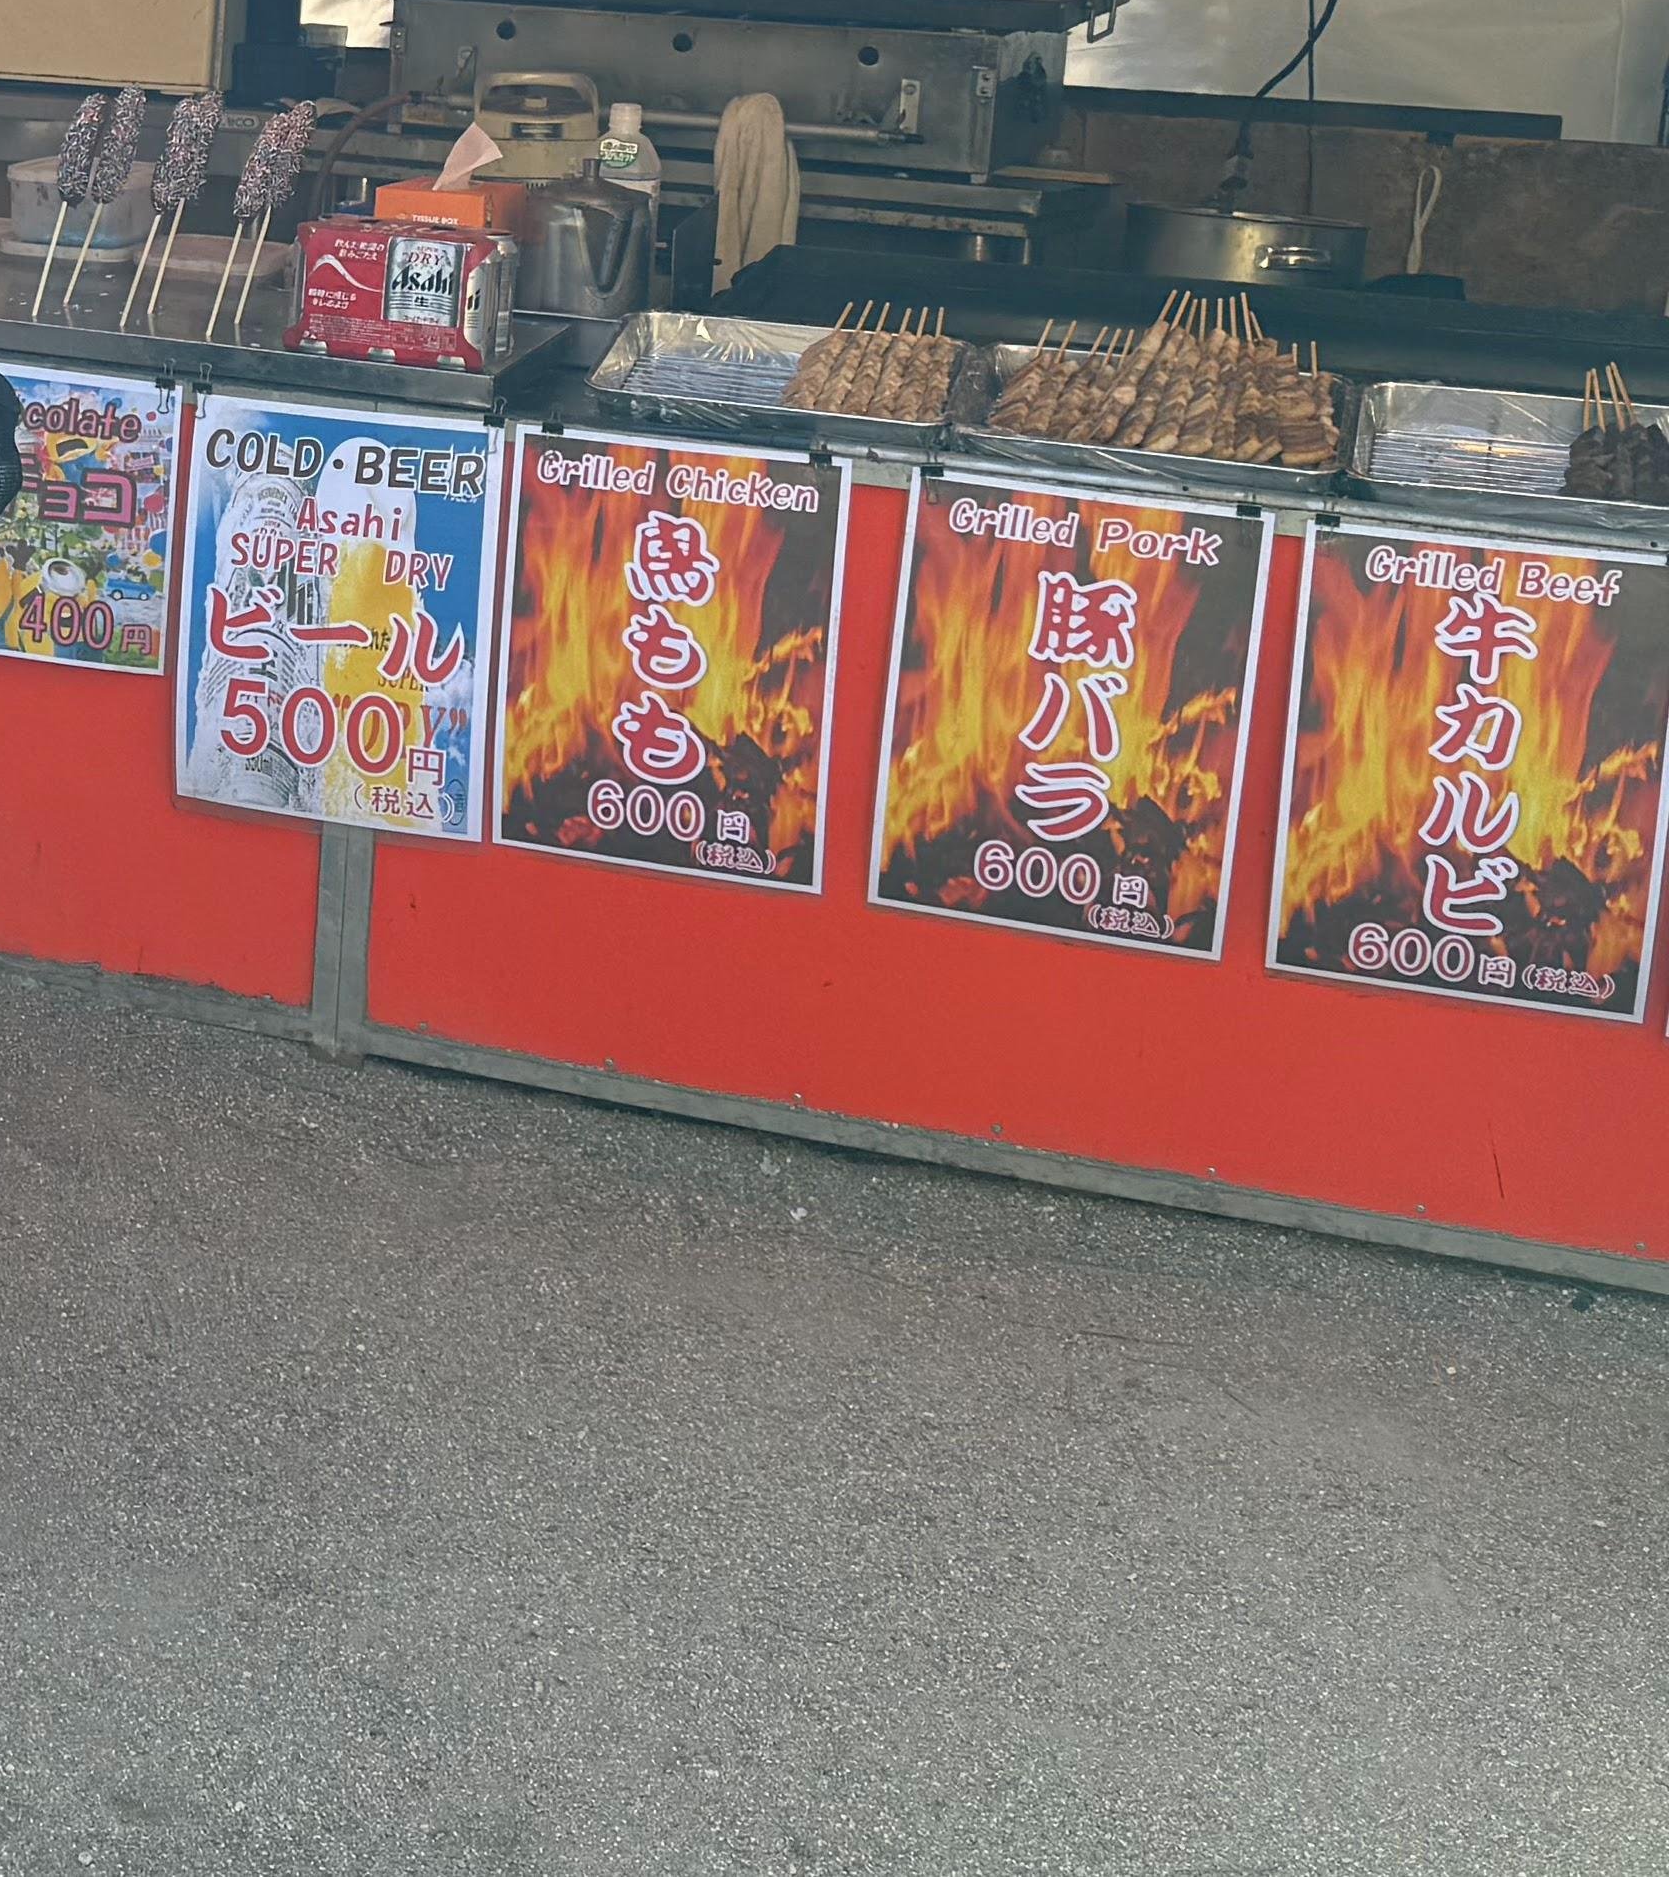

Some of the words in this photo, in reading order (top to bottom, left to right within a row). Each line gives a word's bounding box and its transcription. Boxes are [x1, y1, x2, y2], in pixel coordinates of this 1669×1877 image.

[391, 264, 454, 295] Asahi
[23, 397, 142, 444] colate
[537, 451, 656, 495] Grilled
[296, 496, 404, 542] Asahi
[947, 497, 1080, 550] Grilled
[230, 532, 340, 576] SUPER
[384, 549, 454, 591] DRY
[1364, 544, 1503, 596] Grilled
[1514, 560, 1623, 608] Beef
[19, 594, 153, 656] 400円
[207, 585, 464, 688] ビール
[219, 676, 447, 789] 500円
[1015, 570, 1138, 842] 豚バラ
[1418, 593, 1539, 938] 牛カルビ
[353, 782, 456, 822] (税込)
[587, 778, 751, 843] 600円
[694, 840, 778, 874] (税込)
[973, 838, 1150, 908] 600円
[1087, 903, 1175, 941] (税込)
